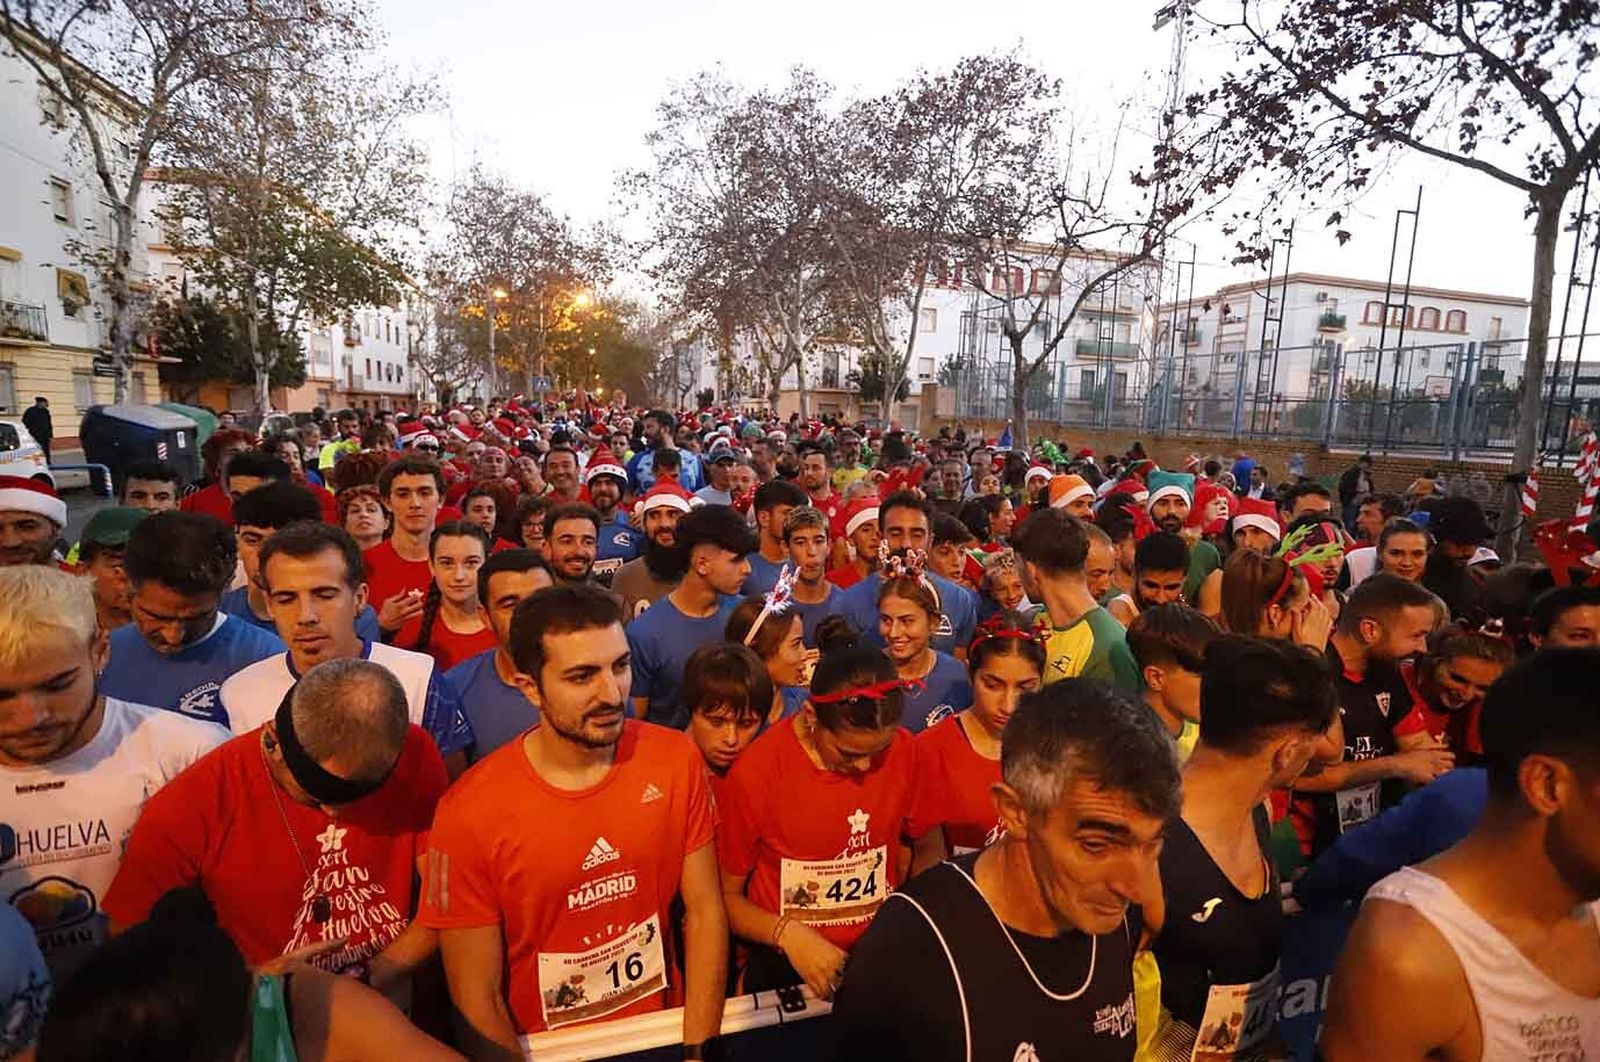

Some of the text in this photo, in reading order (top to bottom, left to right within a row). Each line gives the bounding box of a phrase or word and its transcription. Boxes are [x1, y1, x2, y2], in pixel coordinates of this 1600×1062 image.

[16, 819, 110, 857] HUELVA
[582, 851, 621, 870] adidas
[567, 876, 636, 910] MADRID
[826, 871, 877, 903] 424
[605, 952, 643, 989] 16
